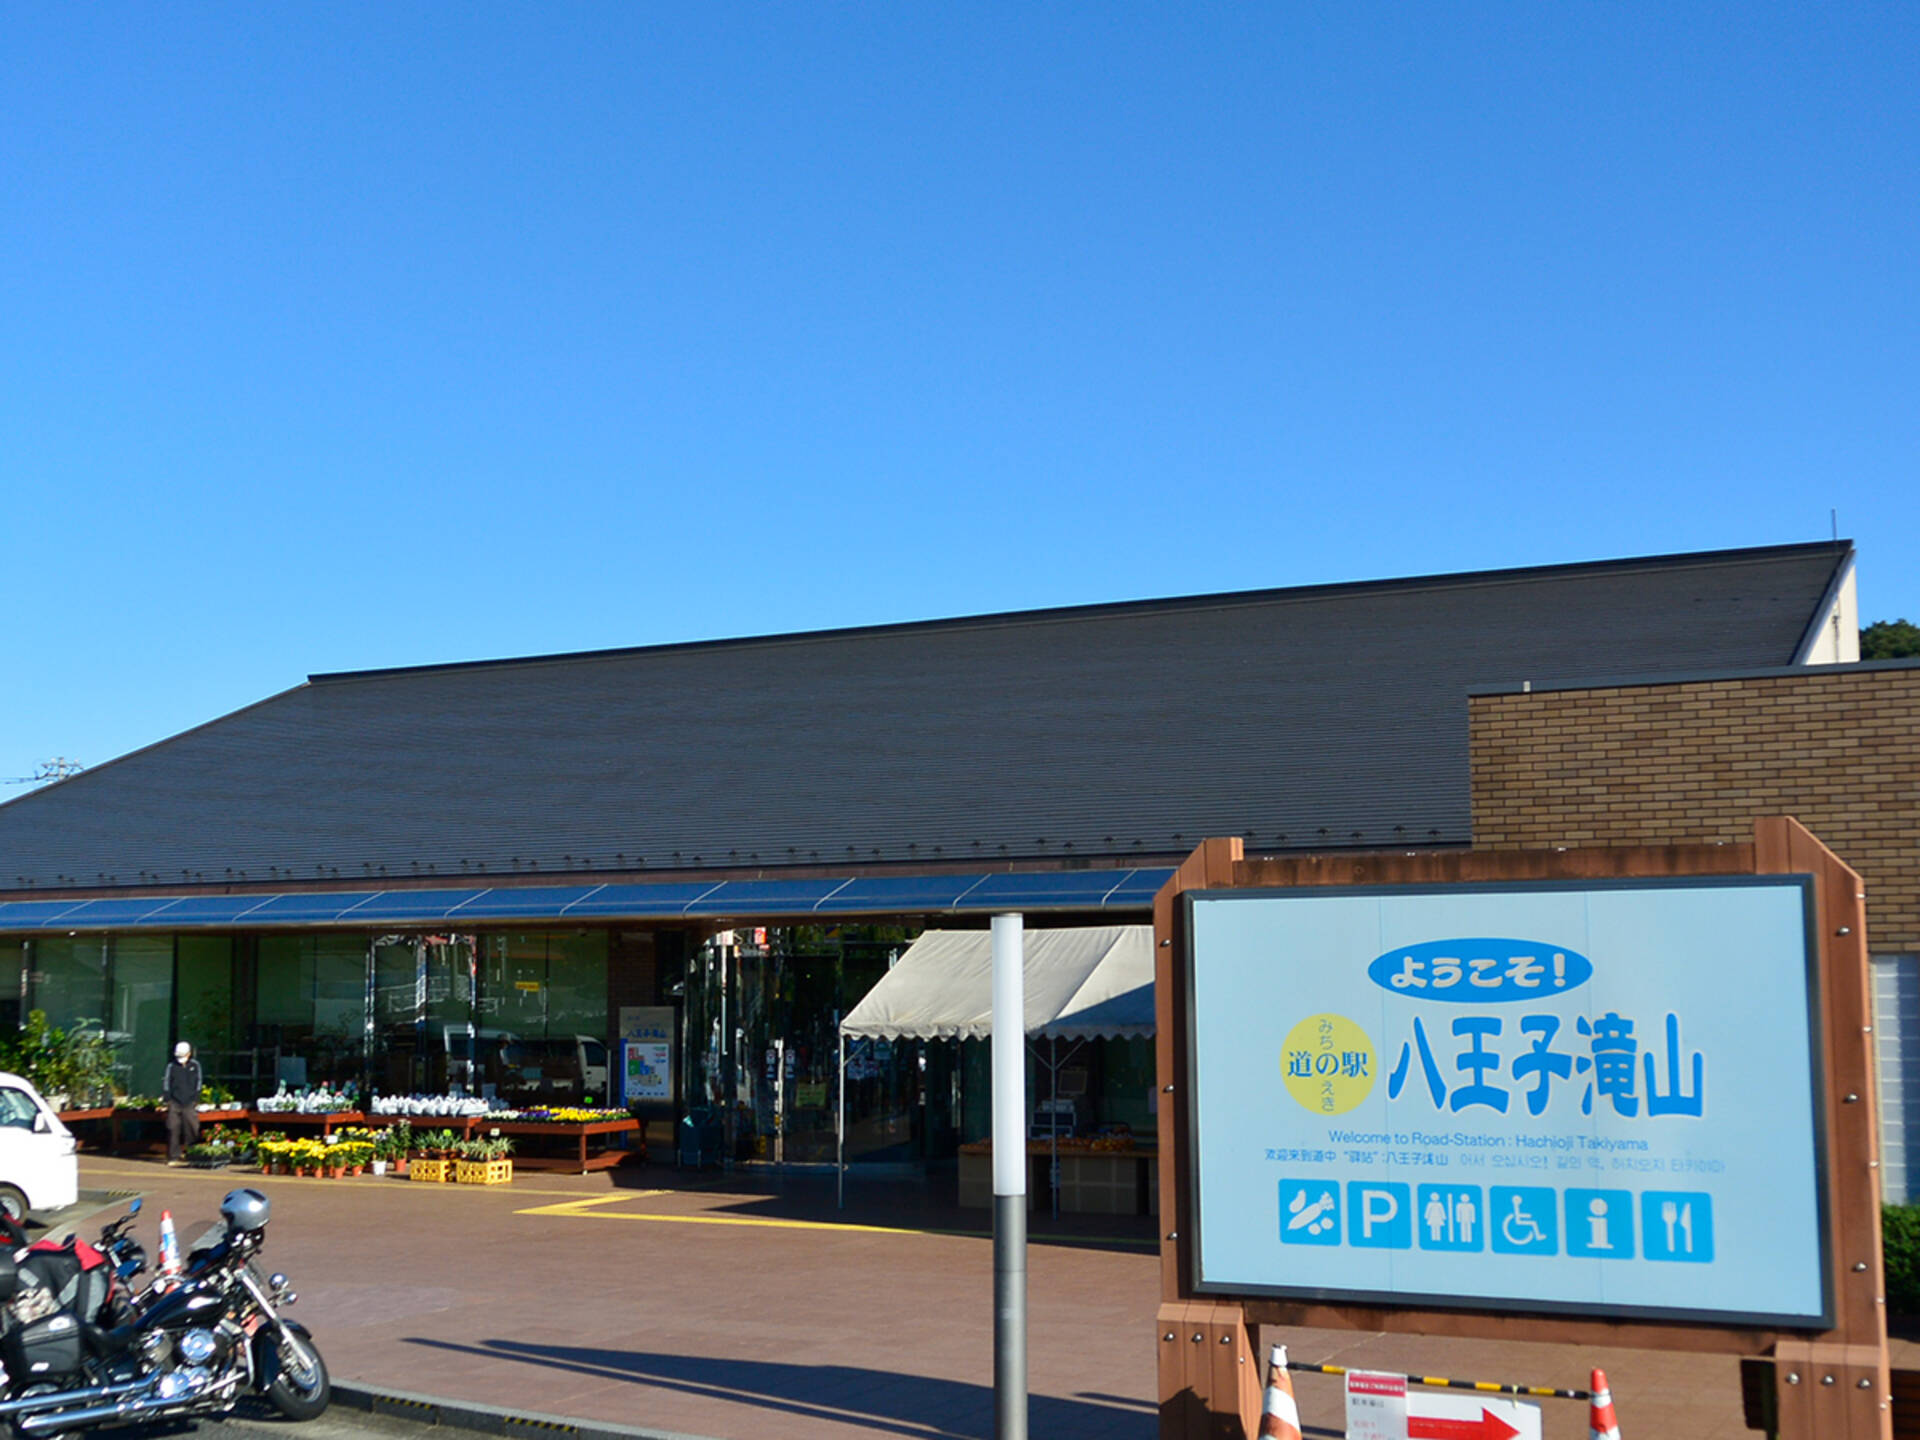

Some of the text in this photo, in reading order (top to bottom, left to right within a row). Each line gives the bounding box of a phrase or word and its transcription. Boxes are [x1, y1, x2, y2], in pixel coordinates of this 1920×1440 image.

[1390, 953, 1566, 988] ようこそ!
[1319, 1018, 1335, 1051] みち
[1287, 1050, 1369, 1078] 道の駅
[1387, 1011, 1704, 1118] 八王子滝山
[1320, 1080, 1335, 1112] えき
[1328, 1130, 1391, 1145] Welcome
[1394, 1133, 1410, 1145] to
[1515, 1134, 1574, 1152] Hachioji
[1576, 1135, 1649, 1153] Takiyama
